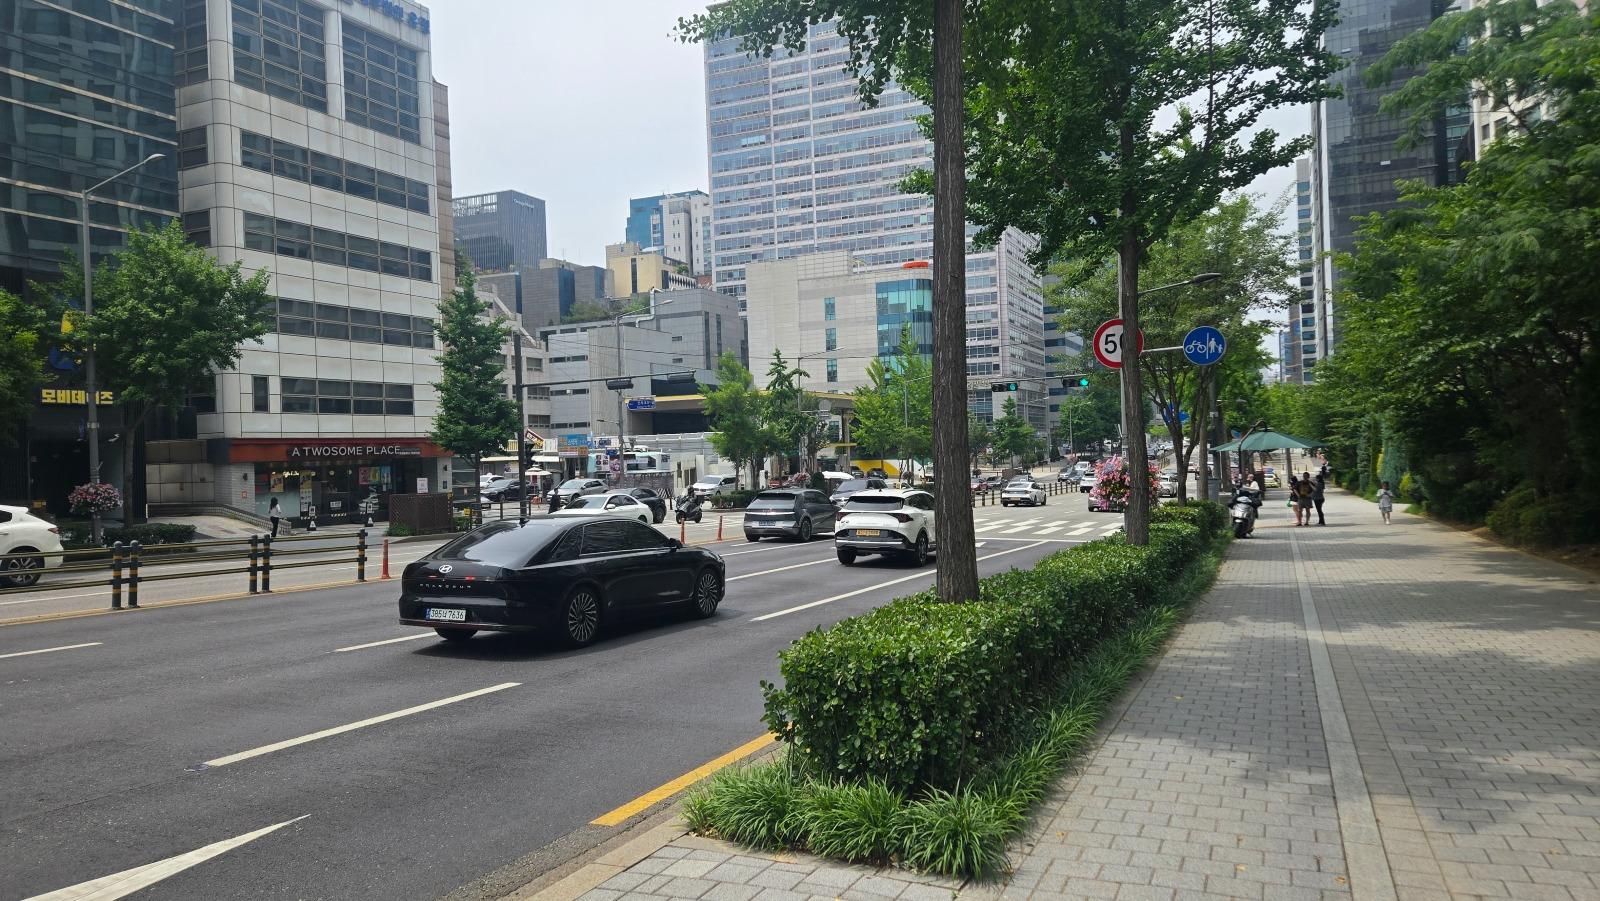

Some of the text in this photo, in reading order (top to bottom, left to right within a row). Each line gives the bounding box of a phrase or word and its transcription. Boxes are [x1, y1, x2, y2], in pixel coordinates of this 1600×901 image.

[1104, 333, 1123, 354] 5
[291, 447, 301, 457] A
[303, 446, 363, 456] TWOSOME
[366, 445, 400, 455] PLACE
[448, 610, 464, 620] 7636
